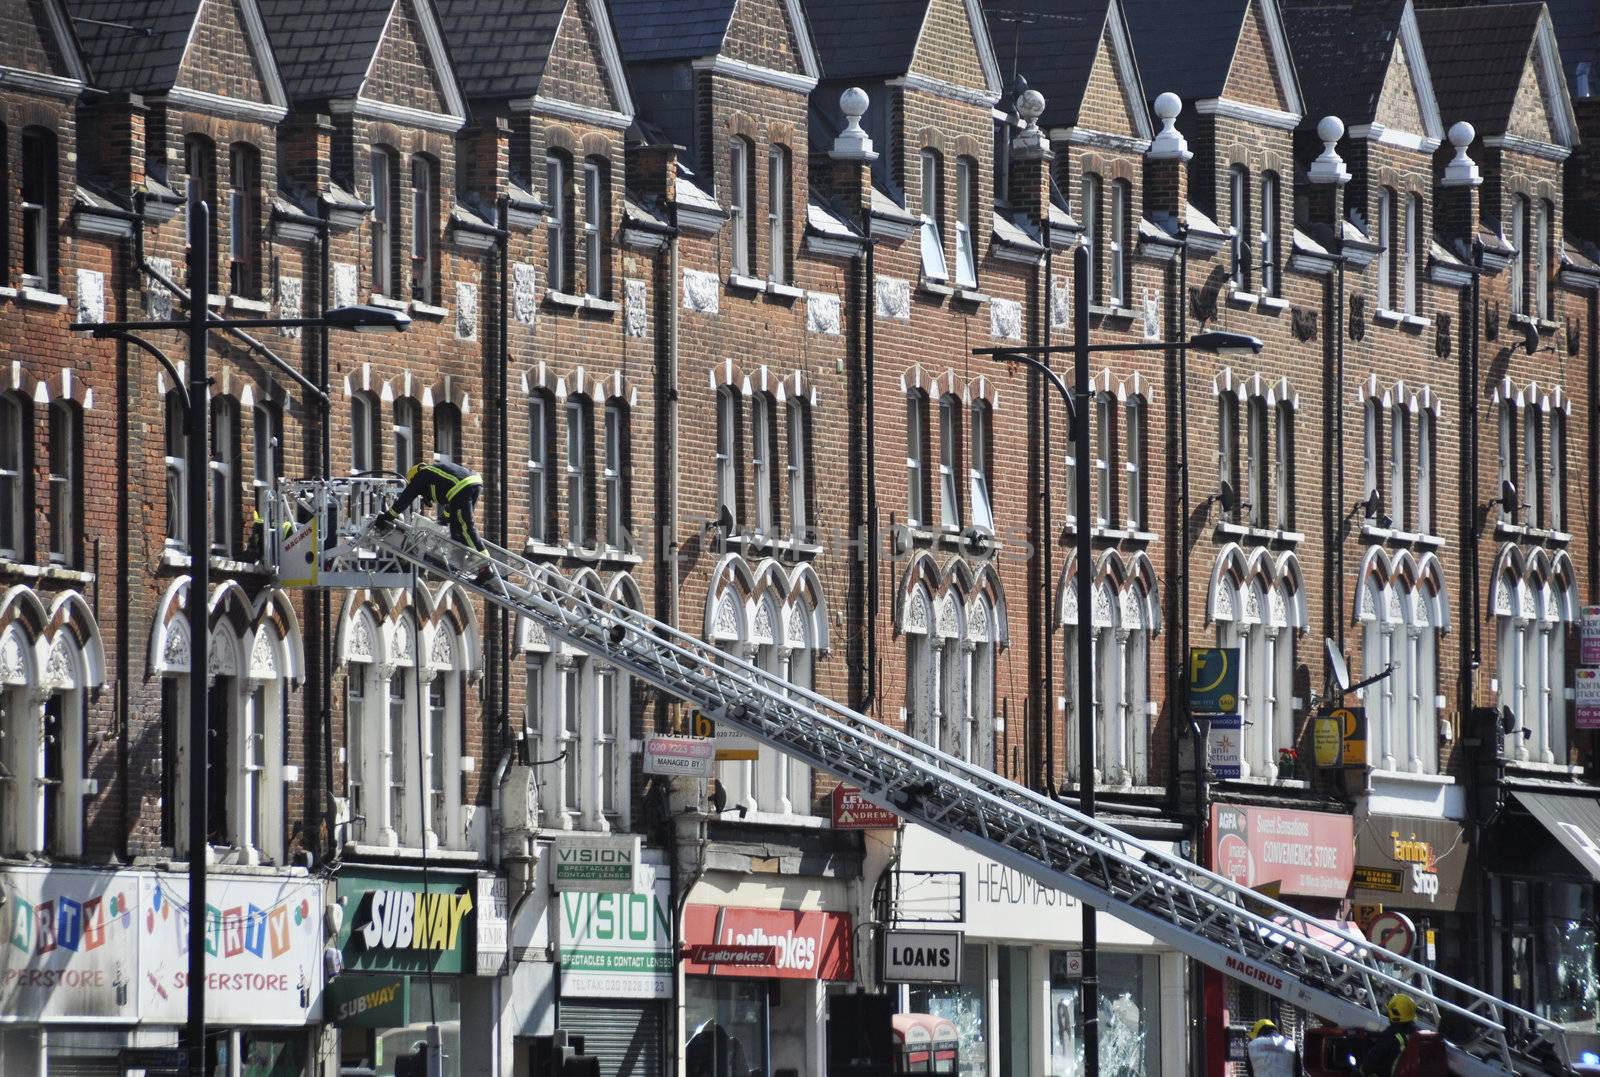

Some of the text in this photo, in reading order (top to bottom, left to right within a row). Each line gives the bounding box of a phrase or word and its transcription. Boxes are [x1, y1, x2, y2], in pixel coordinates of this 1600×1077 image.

[284, 527, 313, 551] MAGIRUS
[657, 758, 700, 768] MANAGED BY
[1219, 812, 1238, 829] AGFA
[558, 849, 632, 863] VISION
[1263, 841, 1338, 869] CONVENIENCE STORE
[558, 871, 598, 879] CONTACT
[564, 864, 616, 872] SPECTACLES
[1412, 863, 1439, 903] Shop
[354, 888, 473, 951] SUBWAY
[562, 892, 672, 941] VISION
[562, 953, 673, 969] SPECTACLES & CONTACT LENSES
[701, 950, 766, 962] Ladbrokes
[893, 946, 950, 967] LOANS
[173, 972, 288, 991] SERSTORE
[1225, 955, 1283, 990] MAGIRUS
[337, 981, 400, 1020] SUBWAY
